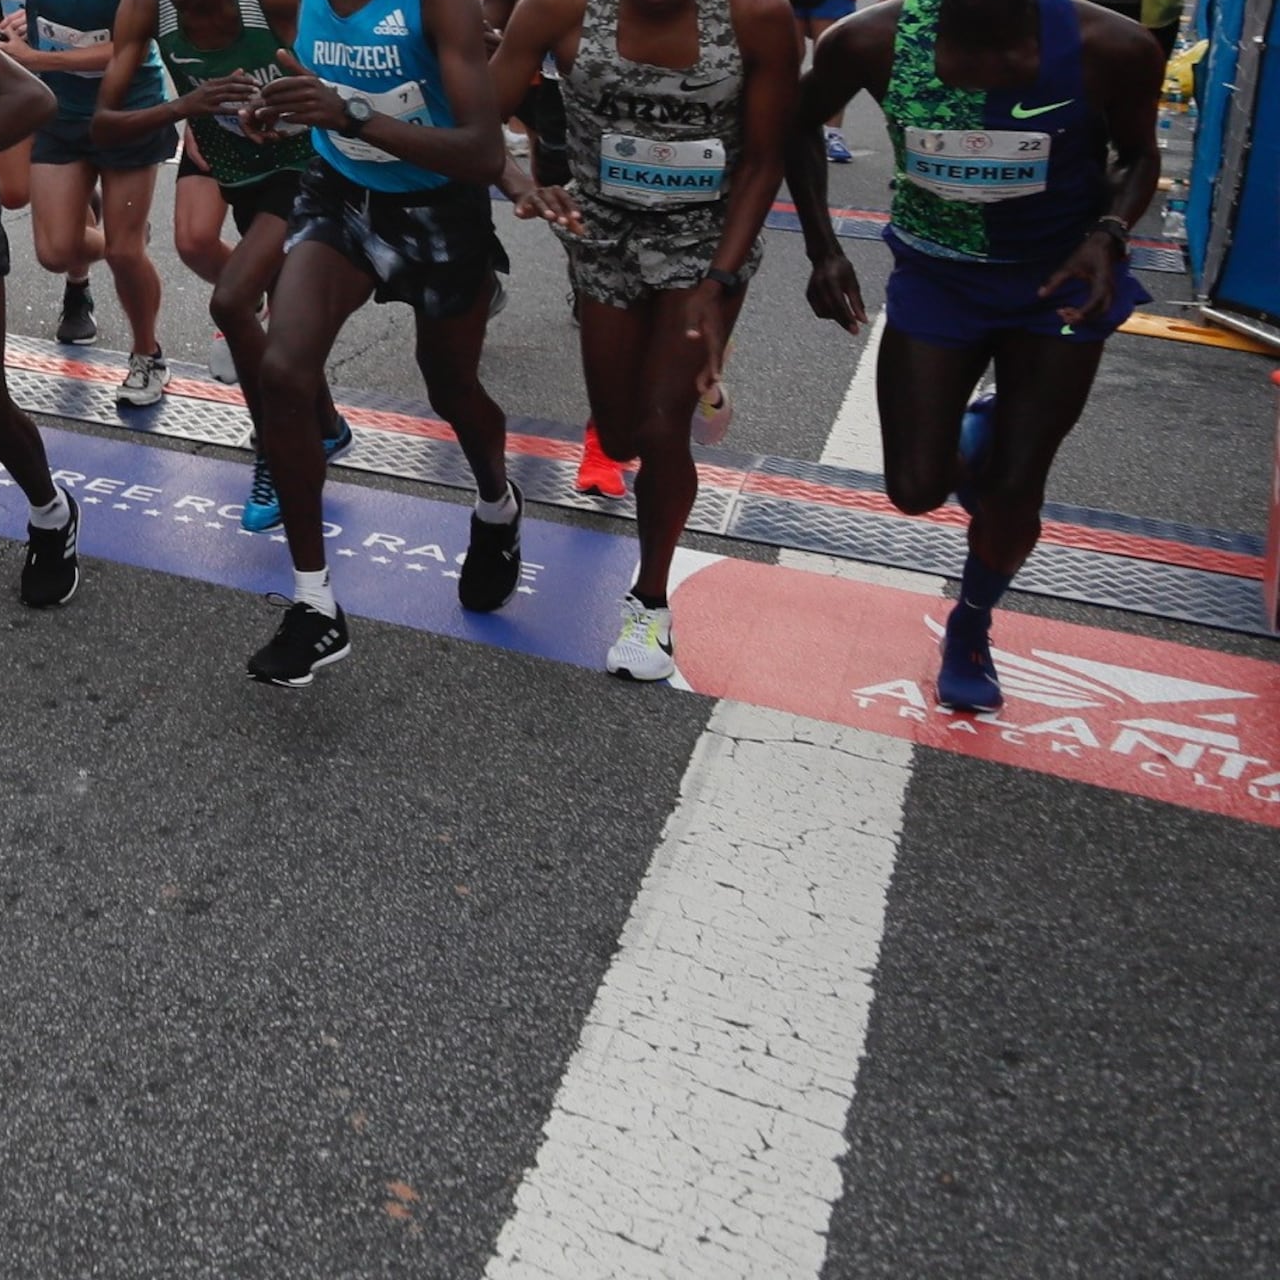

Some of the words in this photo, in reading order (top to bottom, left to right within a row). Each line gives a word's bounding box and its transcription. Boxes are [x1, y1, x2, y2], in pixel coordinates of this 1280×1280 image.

[373, 26, 409, 36] adidas
[399, 93, 409, 104] 7
[703, 149, 713, 159] 8
[1018, 141, 1041, 151] 22
[608, 166, 714, 187] ELKANAH
[916, 160, 1035, 180] STEPHEN
[173, 494, 343, 539] ROD
[362, 531, 545, 583] RAE
[841, 678, 1280, 788] ALANT
[851, 693, 1081, 759] TRACK
[1141, 760, 1280, 802] CLU
